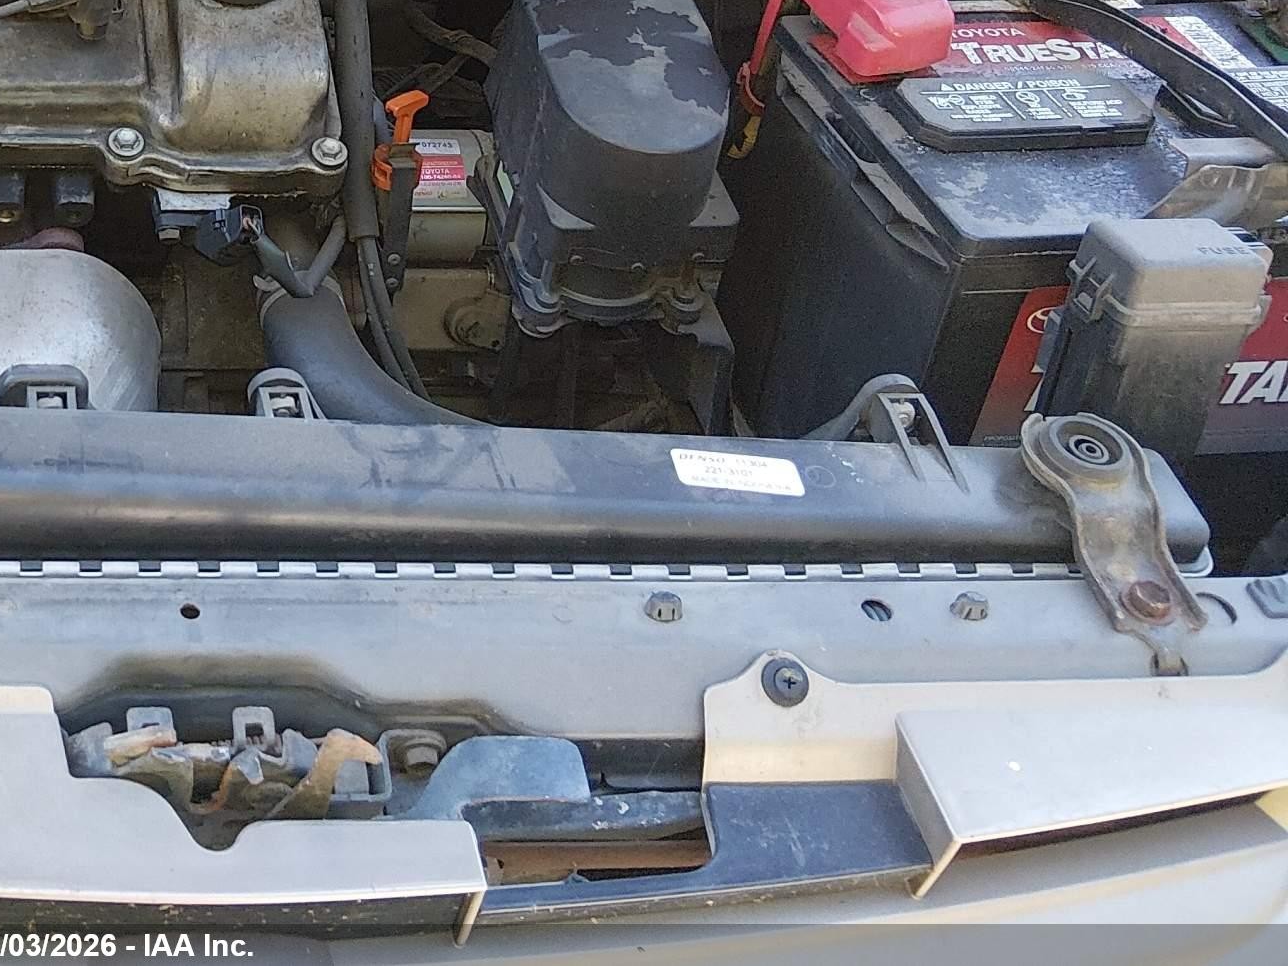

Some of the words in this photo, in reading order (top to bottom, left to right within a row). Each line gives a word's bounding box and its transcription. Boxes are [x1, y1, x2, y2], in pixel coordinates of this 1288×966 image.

[953, 80, 1014, 92] DANGER
[1026, 78, 1081, 90] POISON
[1198, 246, 1253, 256] FUSE
[679, 453, 725, 464] DENSO
